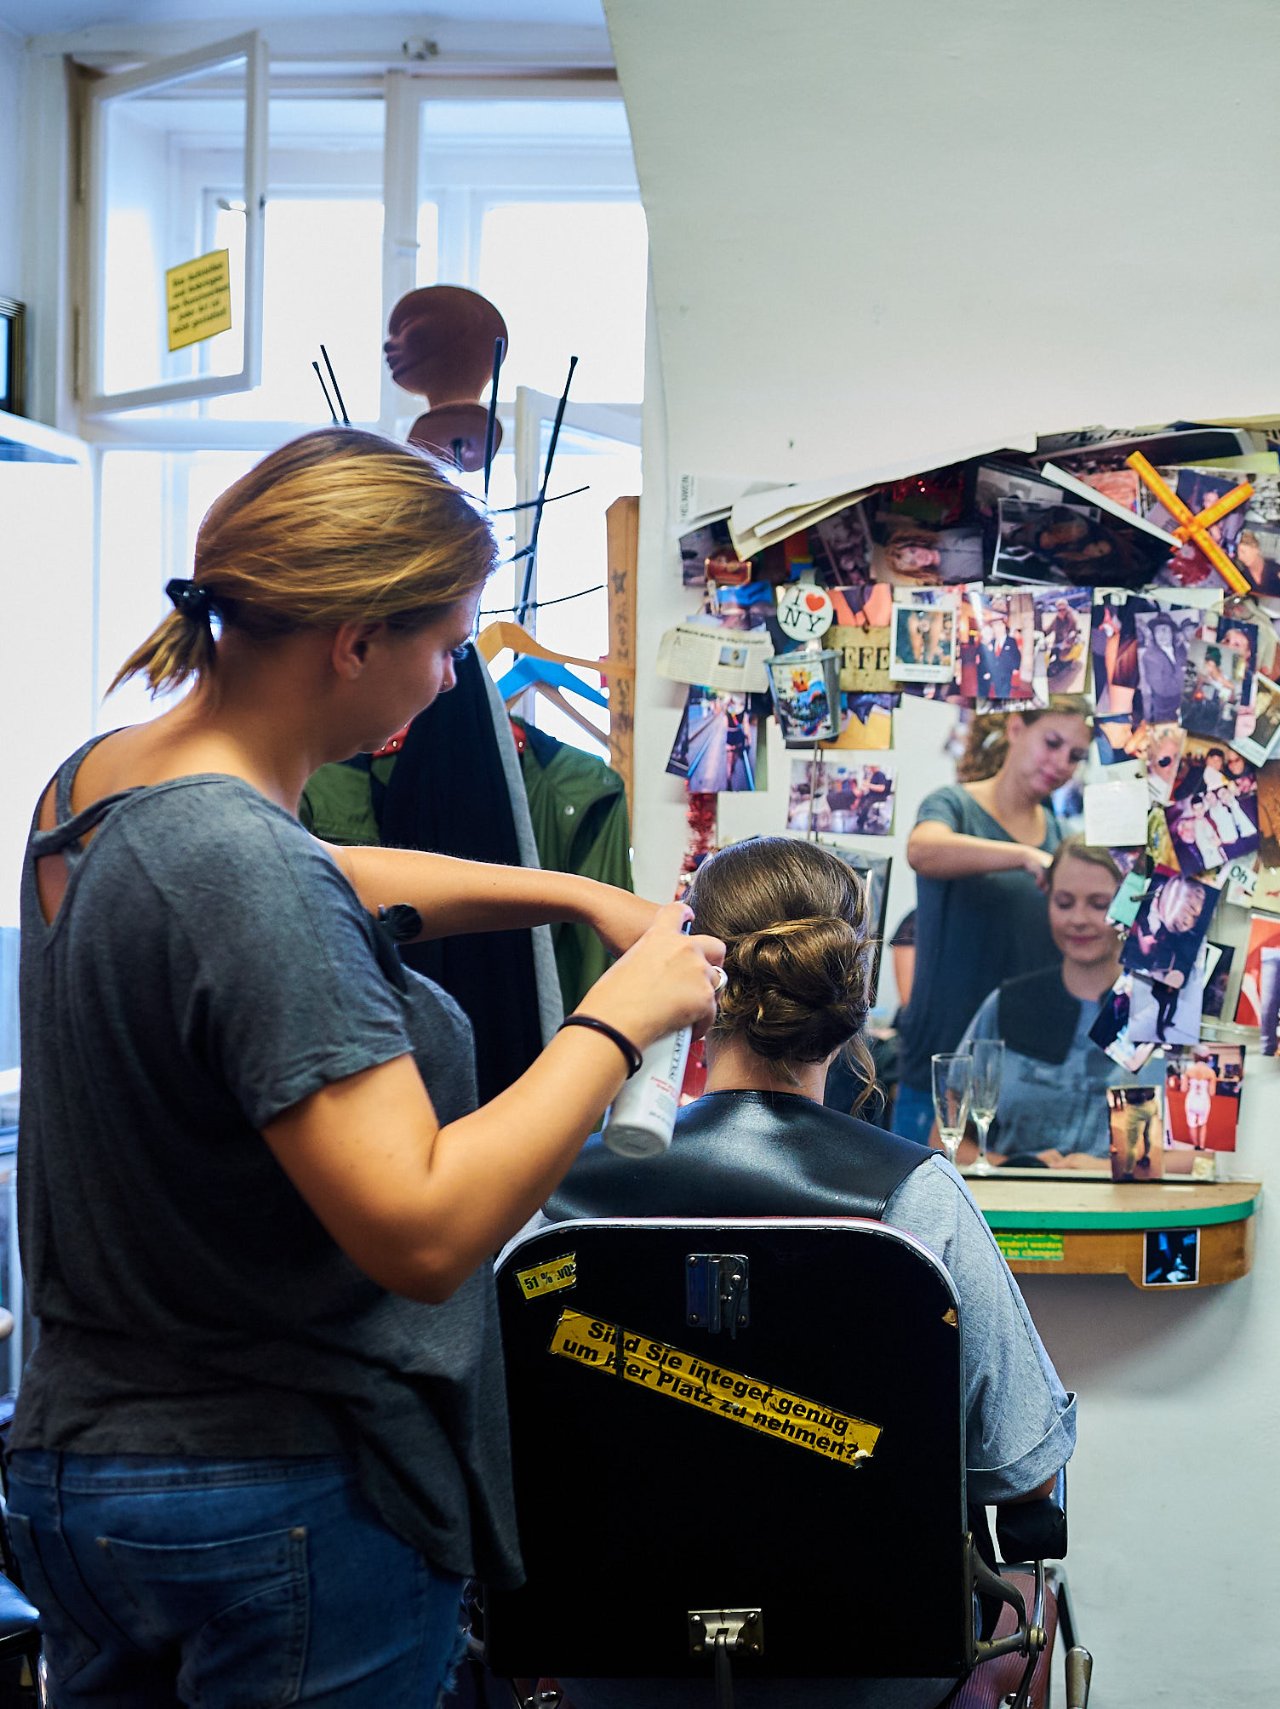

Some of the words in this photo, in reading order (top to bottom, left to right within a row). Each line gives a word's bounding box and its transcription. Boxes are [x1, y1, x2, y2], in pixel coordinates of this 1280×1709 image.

[792, 588, 803, 606] I
[780, 606, 825, 632] NY
[1230, 865, 1248, 885] Oh
[523, 1275, 540, 1290] 51
[540, 1271, 554, 1285] %
[562, 1338, 599, 1363] um
[656, 1370, 715, 1407] Platz
[718, 1399, 748, 1419] zu
[752, 1411, 859, 1460] nehmen?
[646, 1343, 683, 1370] Sie
[688, 1359, 774, 1402] integer
[776, 1397, 849, 1437] genug
